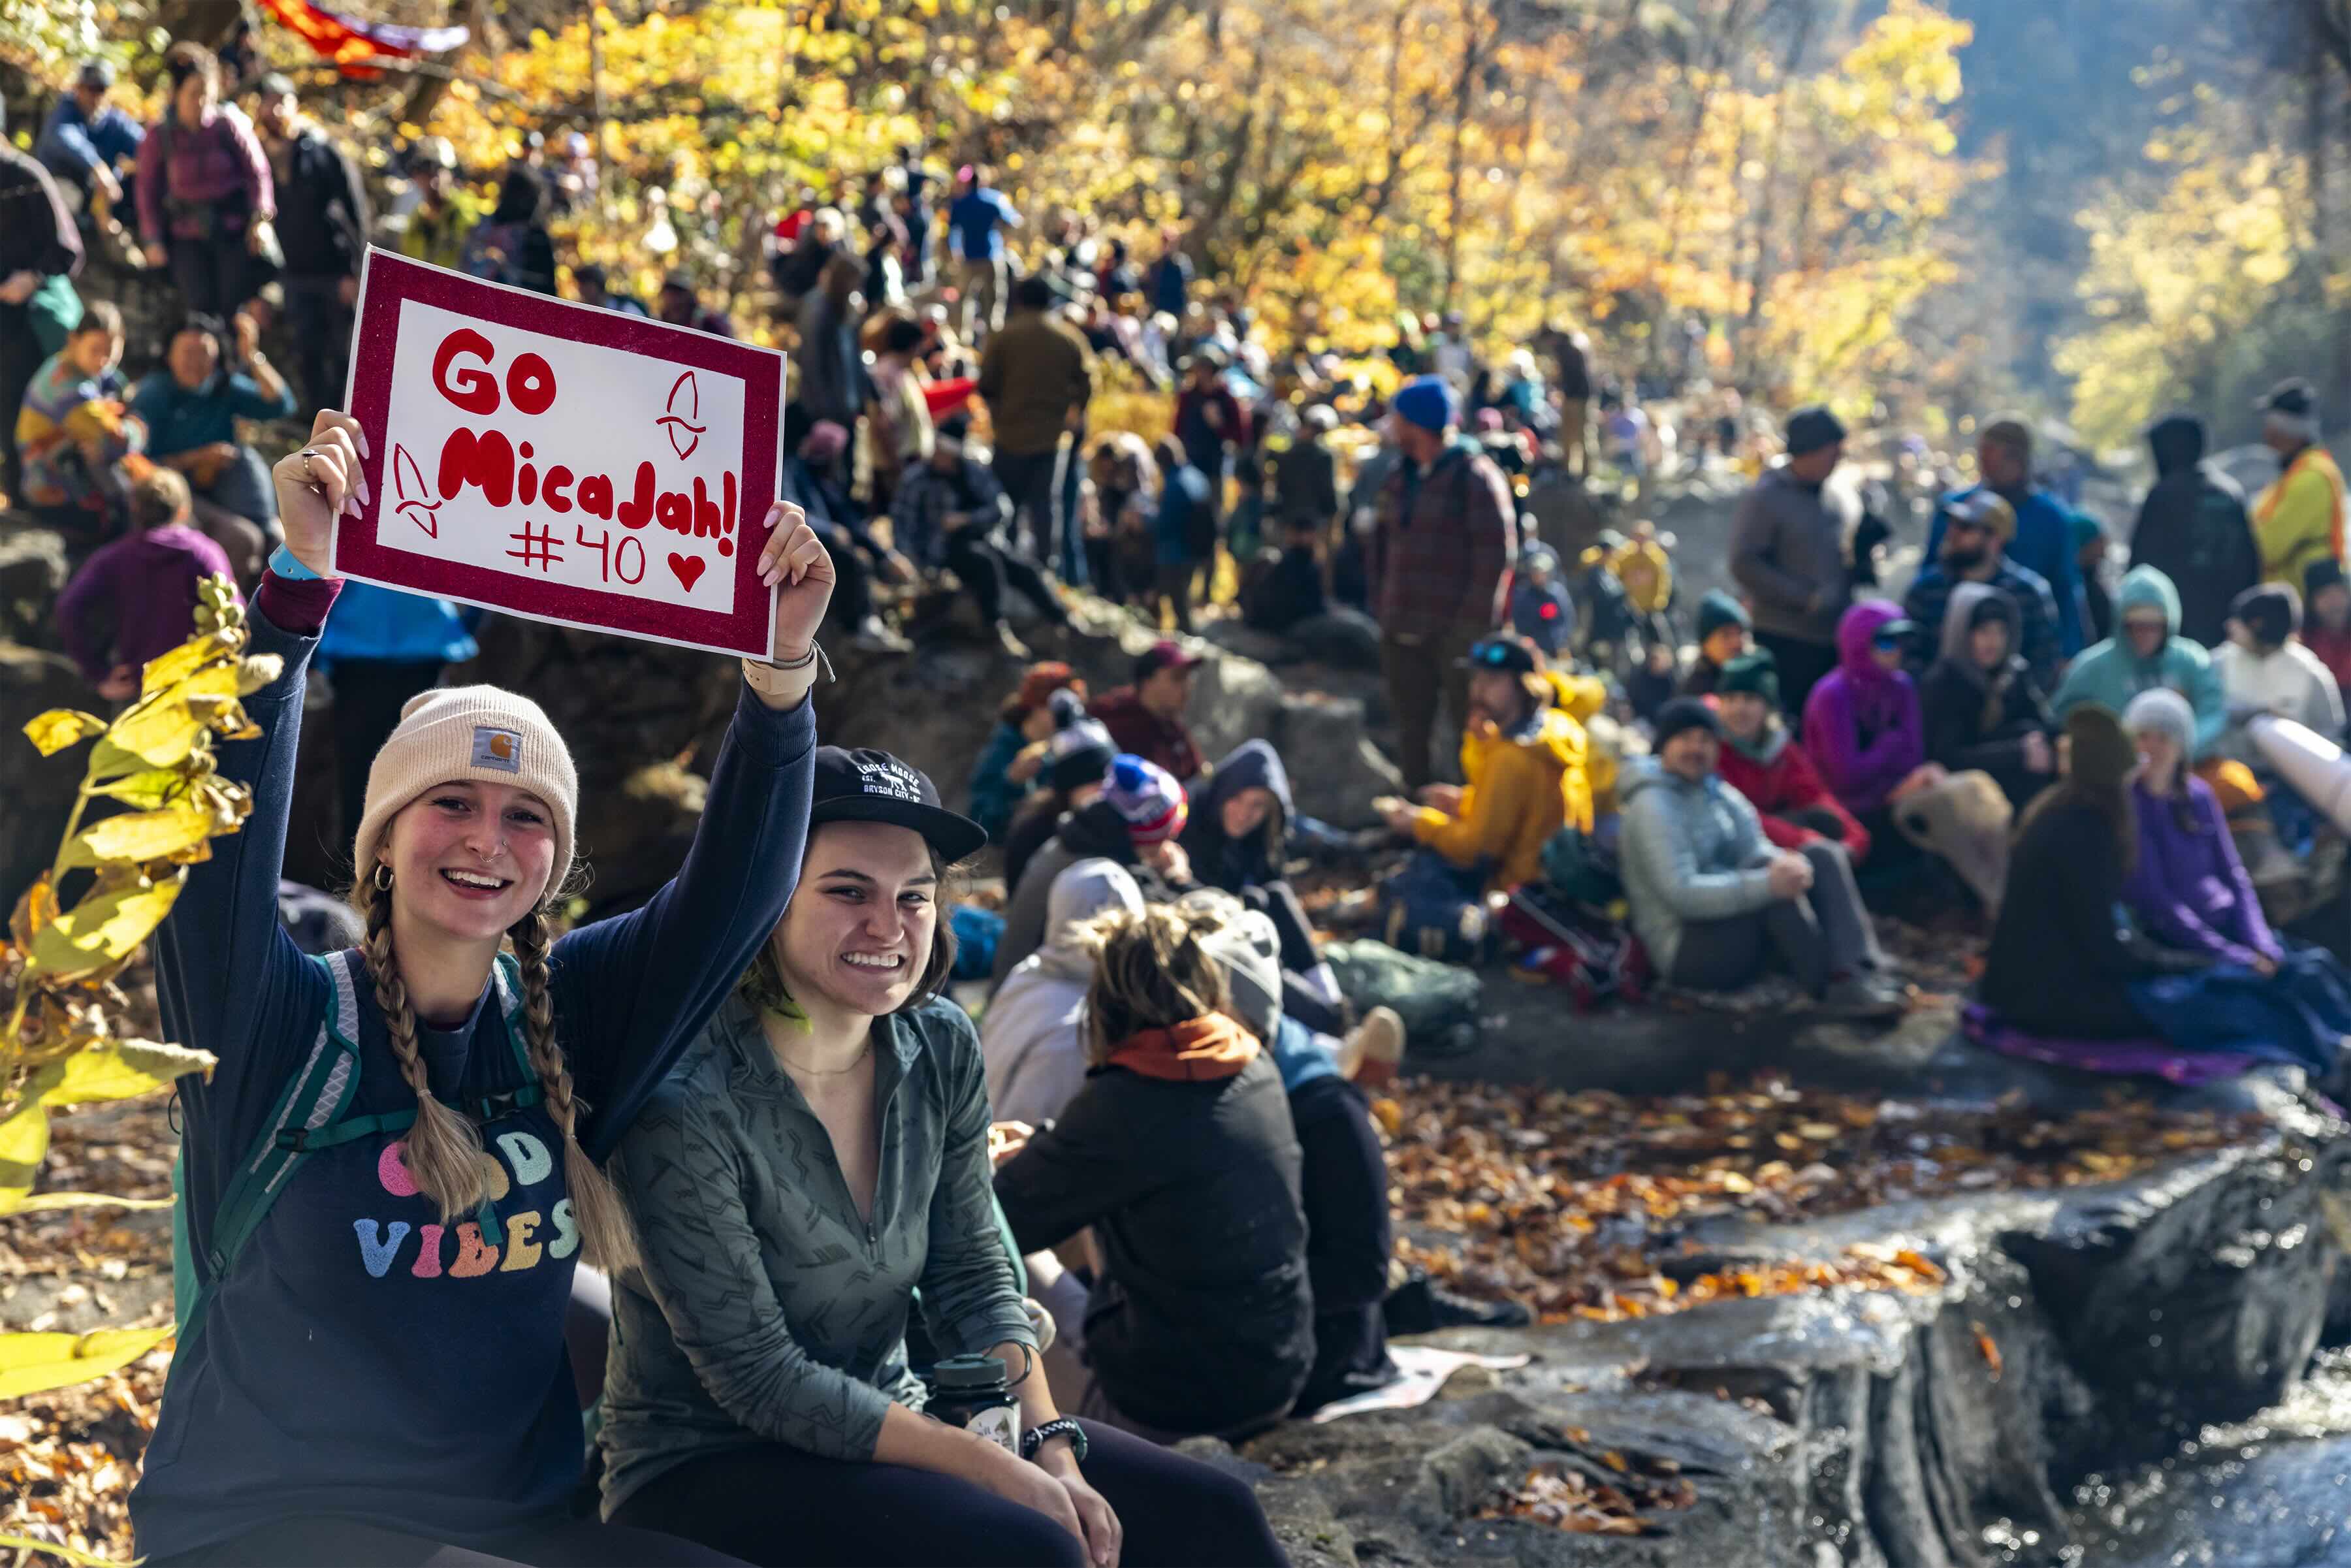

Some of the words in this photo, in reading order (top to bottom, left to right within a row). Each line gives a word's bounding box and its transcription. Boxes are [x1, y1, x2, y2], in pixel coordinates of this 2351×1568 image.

[432, 328, 557, 416] GO
[505, 520, 646, 585] #40
[857, 763, 889, 775] LOOSE
[891, 763, 920, 788] MOOSE
[864, 785, 893, 795] BRYSON
[895, 789, 909, 799] CITY
[353, 1198, 583, 1278] VIBES
